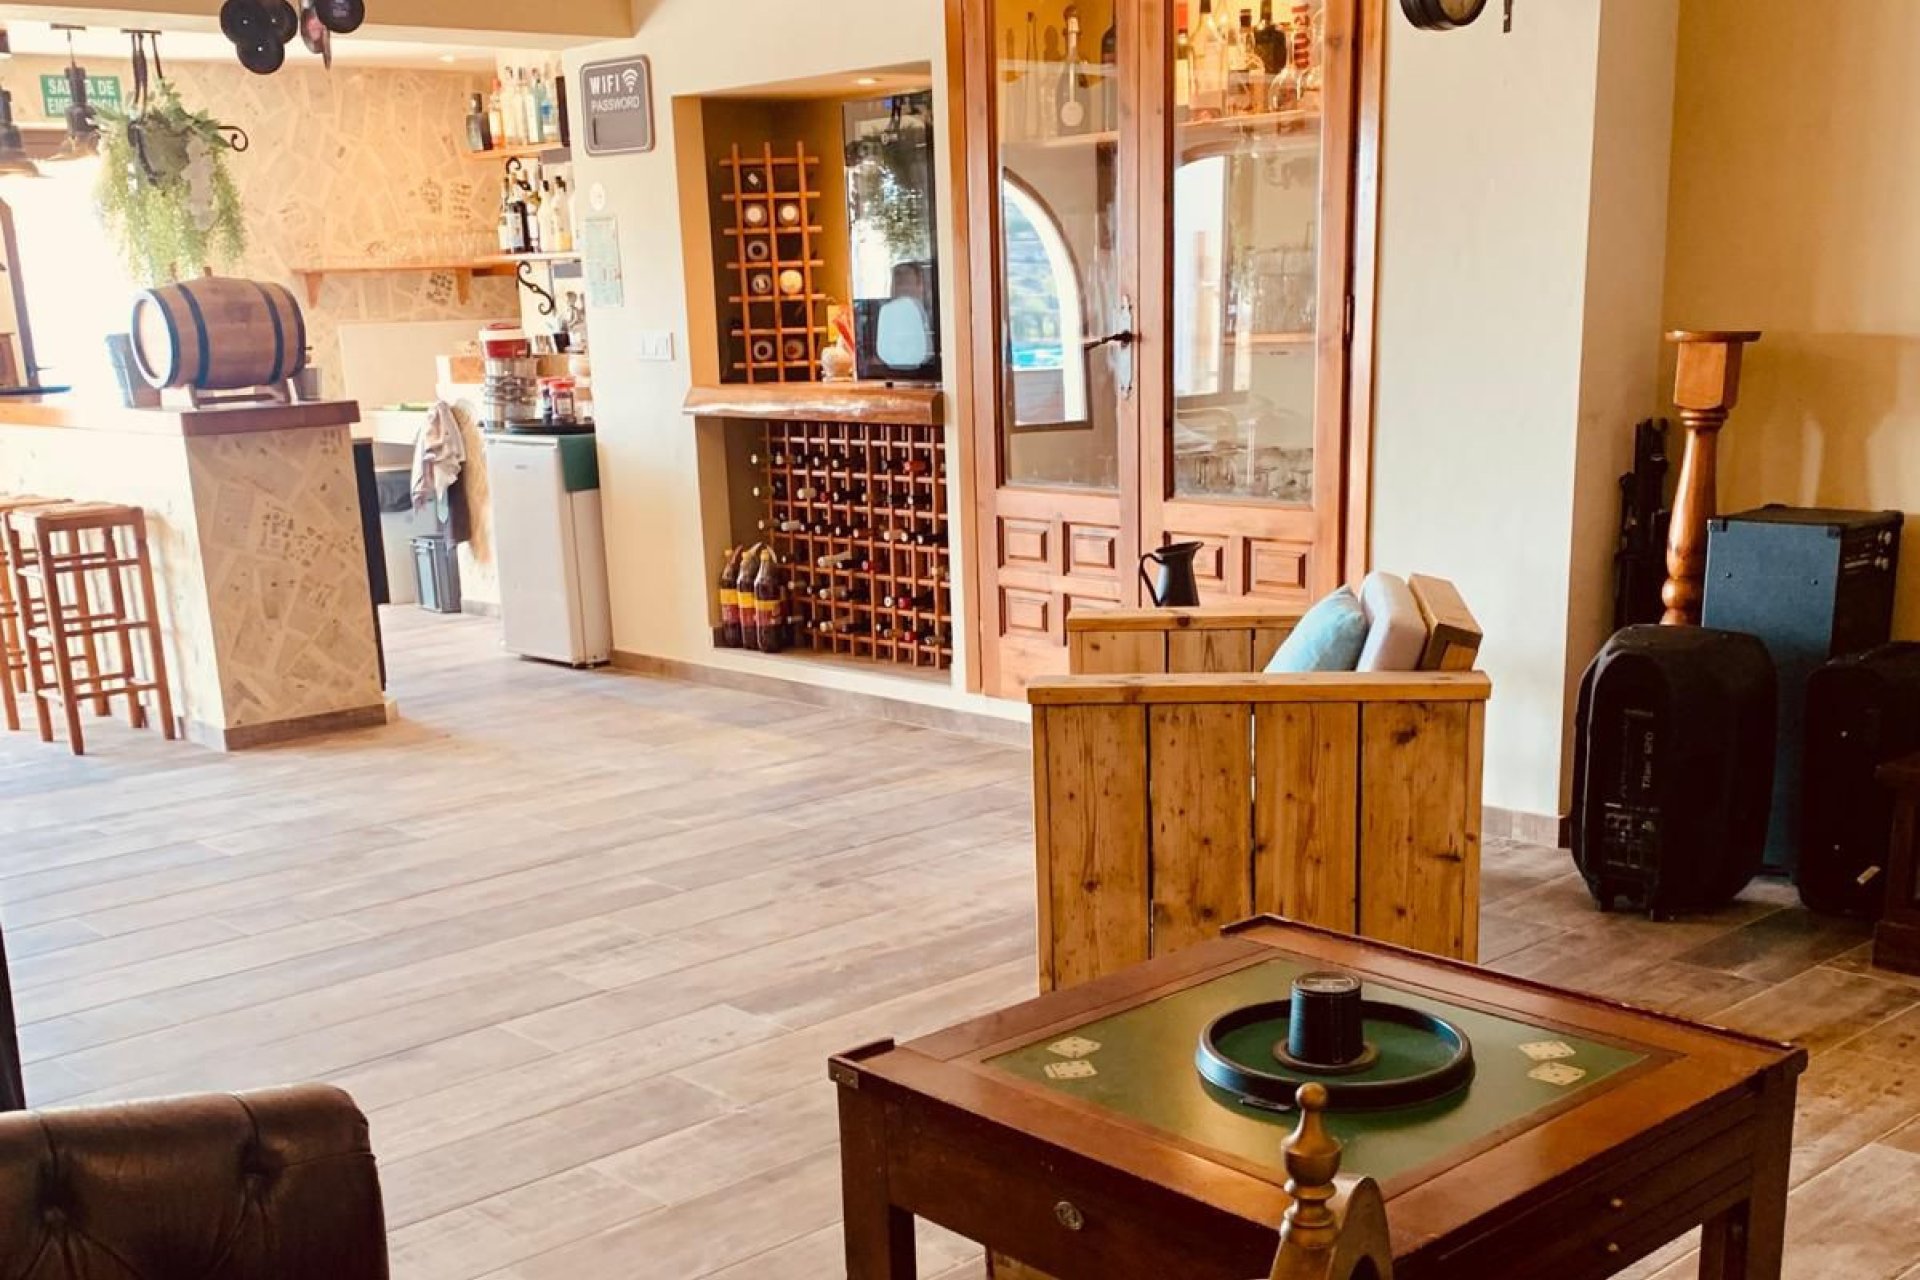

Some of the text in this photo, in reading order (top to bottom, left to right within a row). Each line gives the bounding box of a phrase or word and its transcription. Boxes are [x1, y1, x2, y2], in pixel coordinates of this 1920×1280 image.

[97, 79, 117, 97] DE
[588, 73, 620, 95] WIFI
[590, 95, 641, 113] PASSWORD
